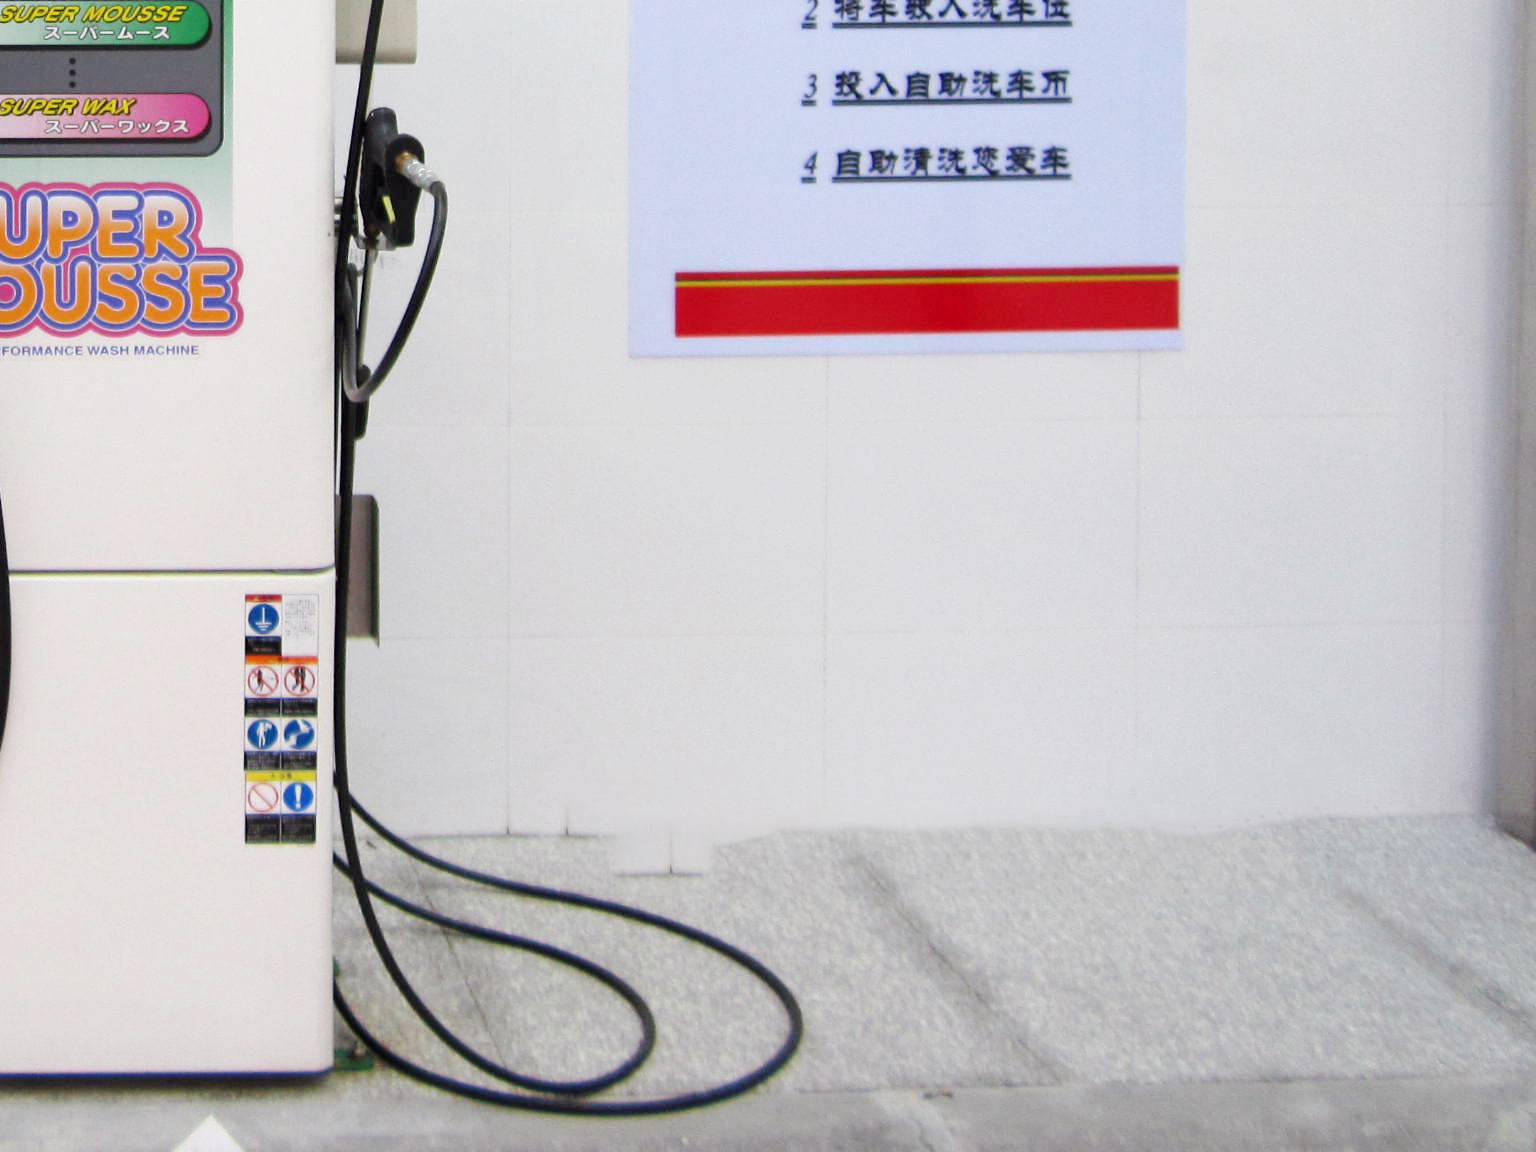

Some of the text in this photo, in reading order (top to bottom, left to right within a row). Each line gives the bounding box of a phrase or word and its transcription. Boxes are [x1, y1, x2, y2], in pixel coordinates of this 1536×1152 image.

[82, 5, 188, 23] MOUSSE
[44, 26, 171, 40] スーパームース
[804, 73, 818, 98] 3
[81, 98, 137, 116] WAX
[45, 119, 189, 134] スーパーワックス
[804, 145, 1070, 177] 4 自助清洗您爱车
[87, 345, 130, 356] WASH
[134, 345, 199, 356] MACHINE
